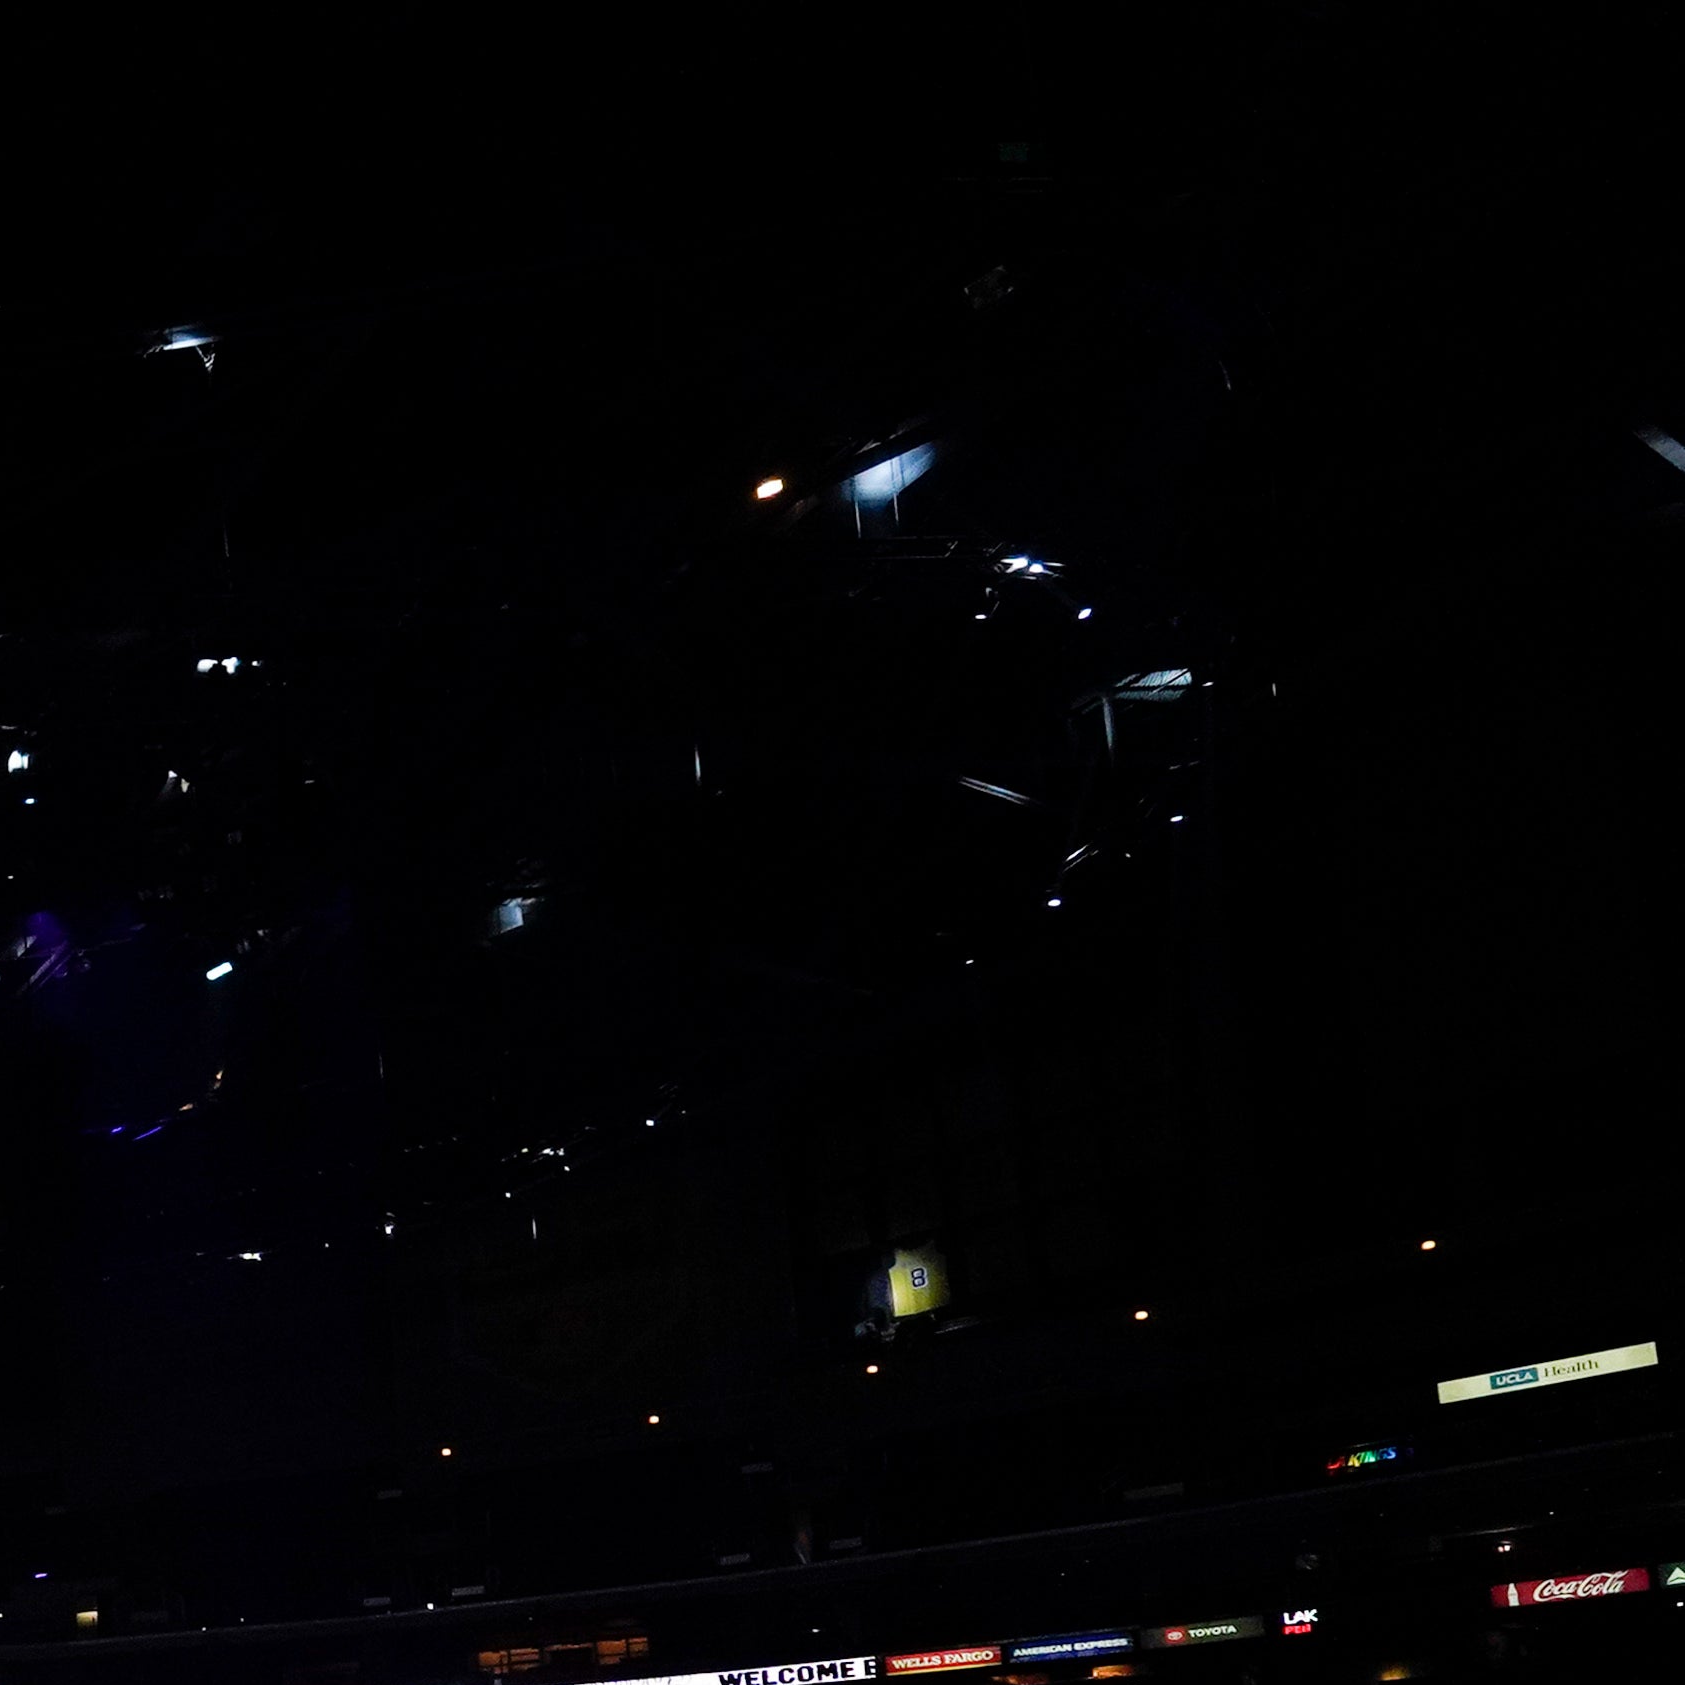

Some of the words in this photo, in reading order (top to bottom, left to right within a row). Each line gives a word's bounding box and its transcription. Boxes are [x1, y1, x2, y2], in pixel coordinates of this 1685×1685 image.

[1495, 1371, 1534, 1387] UCLA
[1544, 1358, 1600, 1378] Health
[1532, 1570, 1629, 1602] Coca-Cola
[1283, 1608, 1318, 1625] LAK
[1188, 1624, 1237, 1637] TOYOTA
[1014, 1643, 1072, 1657] AMERICAN
[1074, 1638, 1129, 1651] EXPRESS
[891, 1655, 942, 1670] WELLS
[944, 1650, 994, 1665] FARGO
